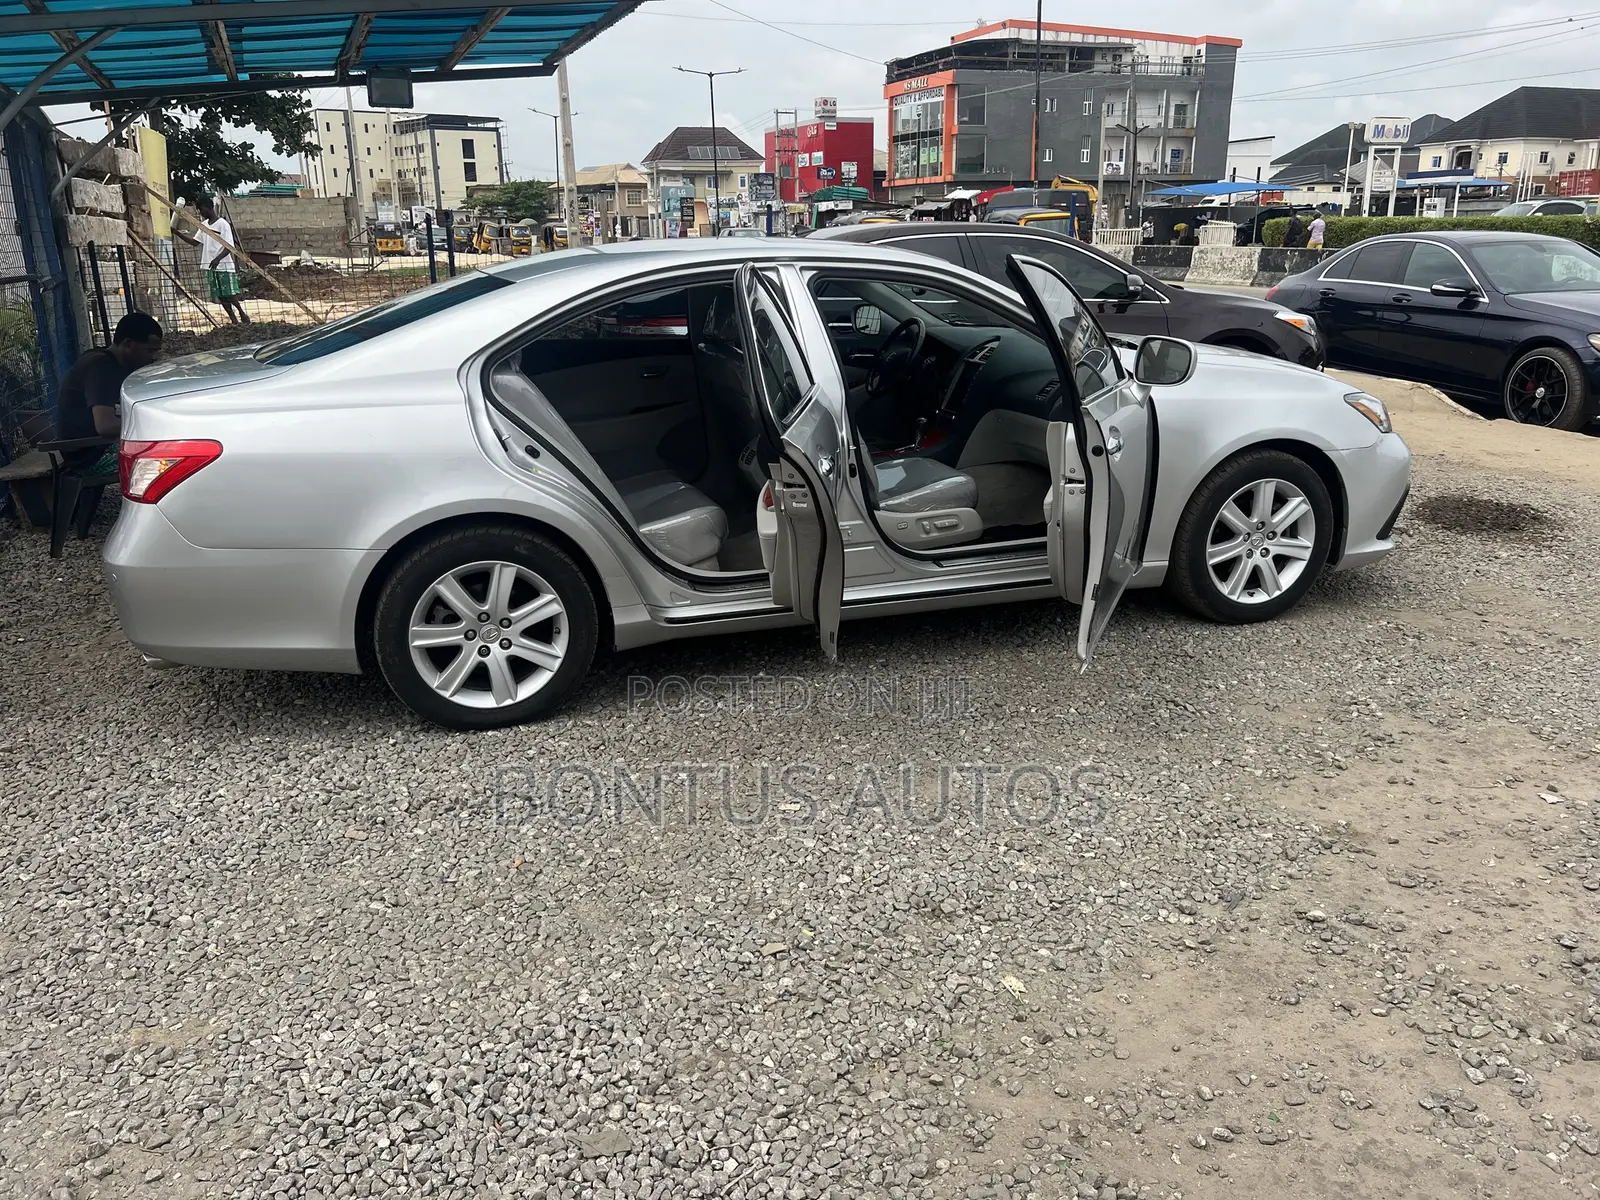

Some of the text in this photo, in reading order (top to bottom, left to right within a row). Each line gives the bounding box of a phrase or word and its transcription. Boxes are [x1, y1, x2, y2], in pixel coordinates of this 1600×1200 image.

[912, 78, 928, 89] MALL
[894, 94, 913, 106] QUALITY
[1372, 124, 1409, 139] Mobil
[677, 188, 686, 196] LG
